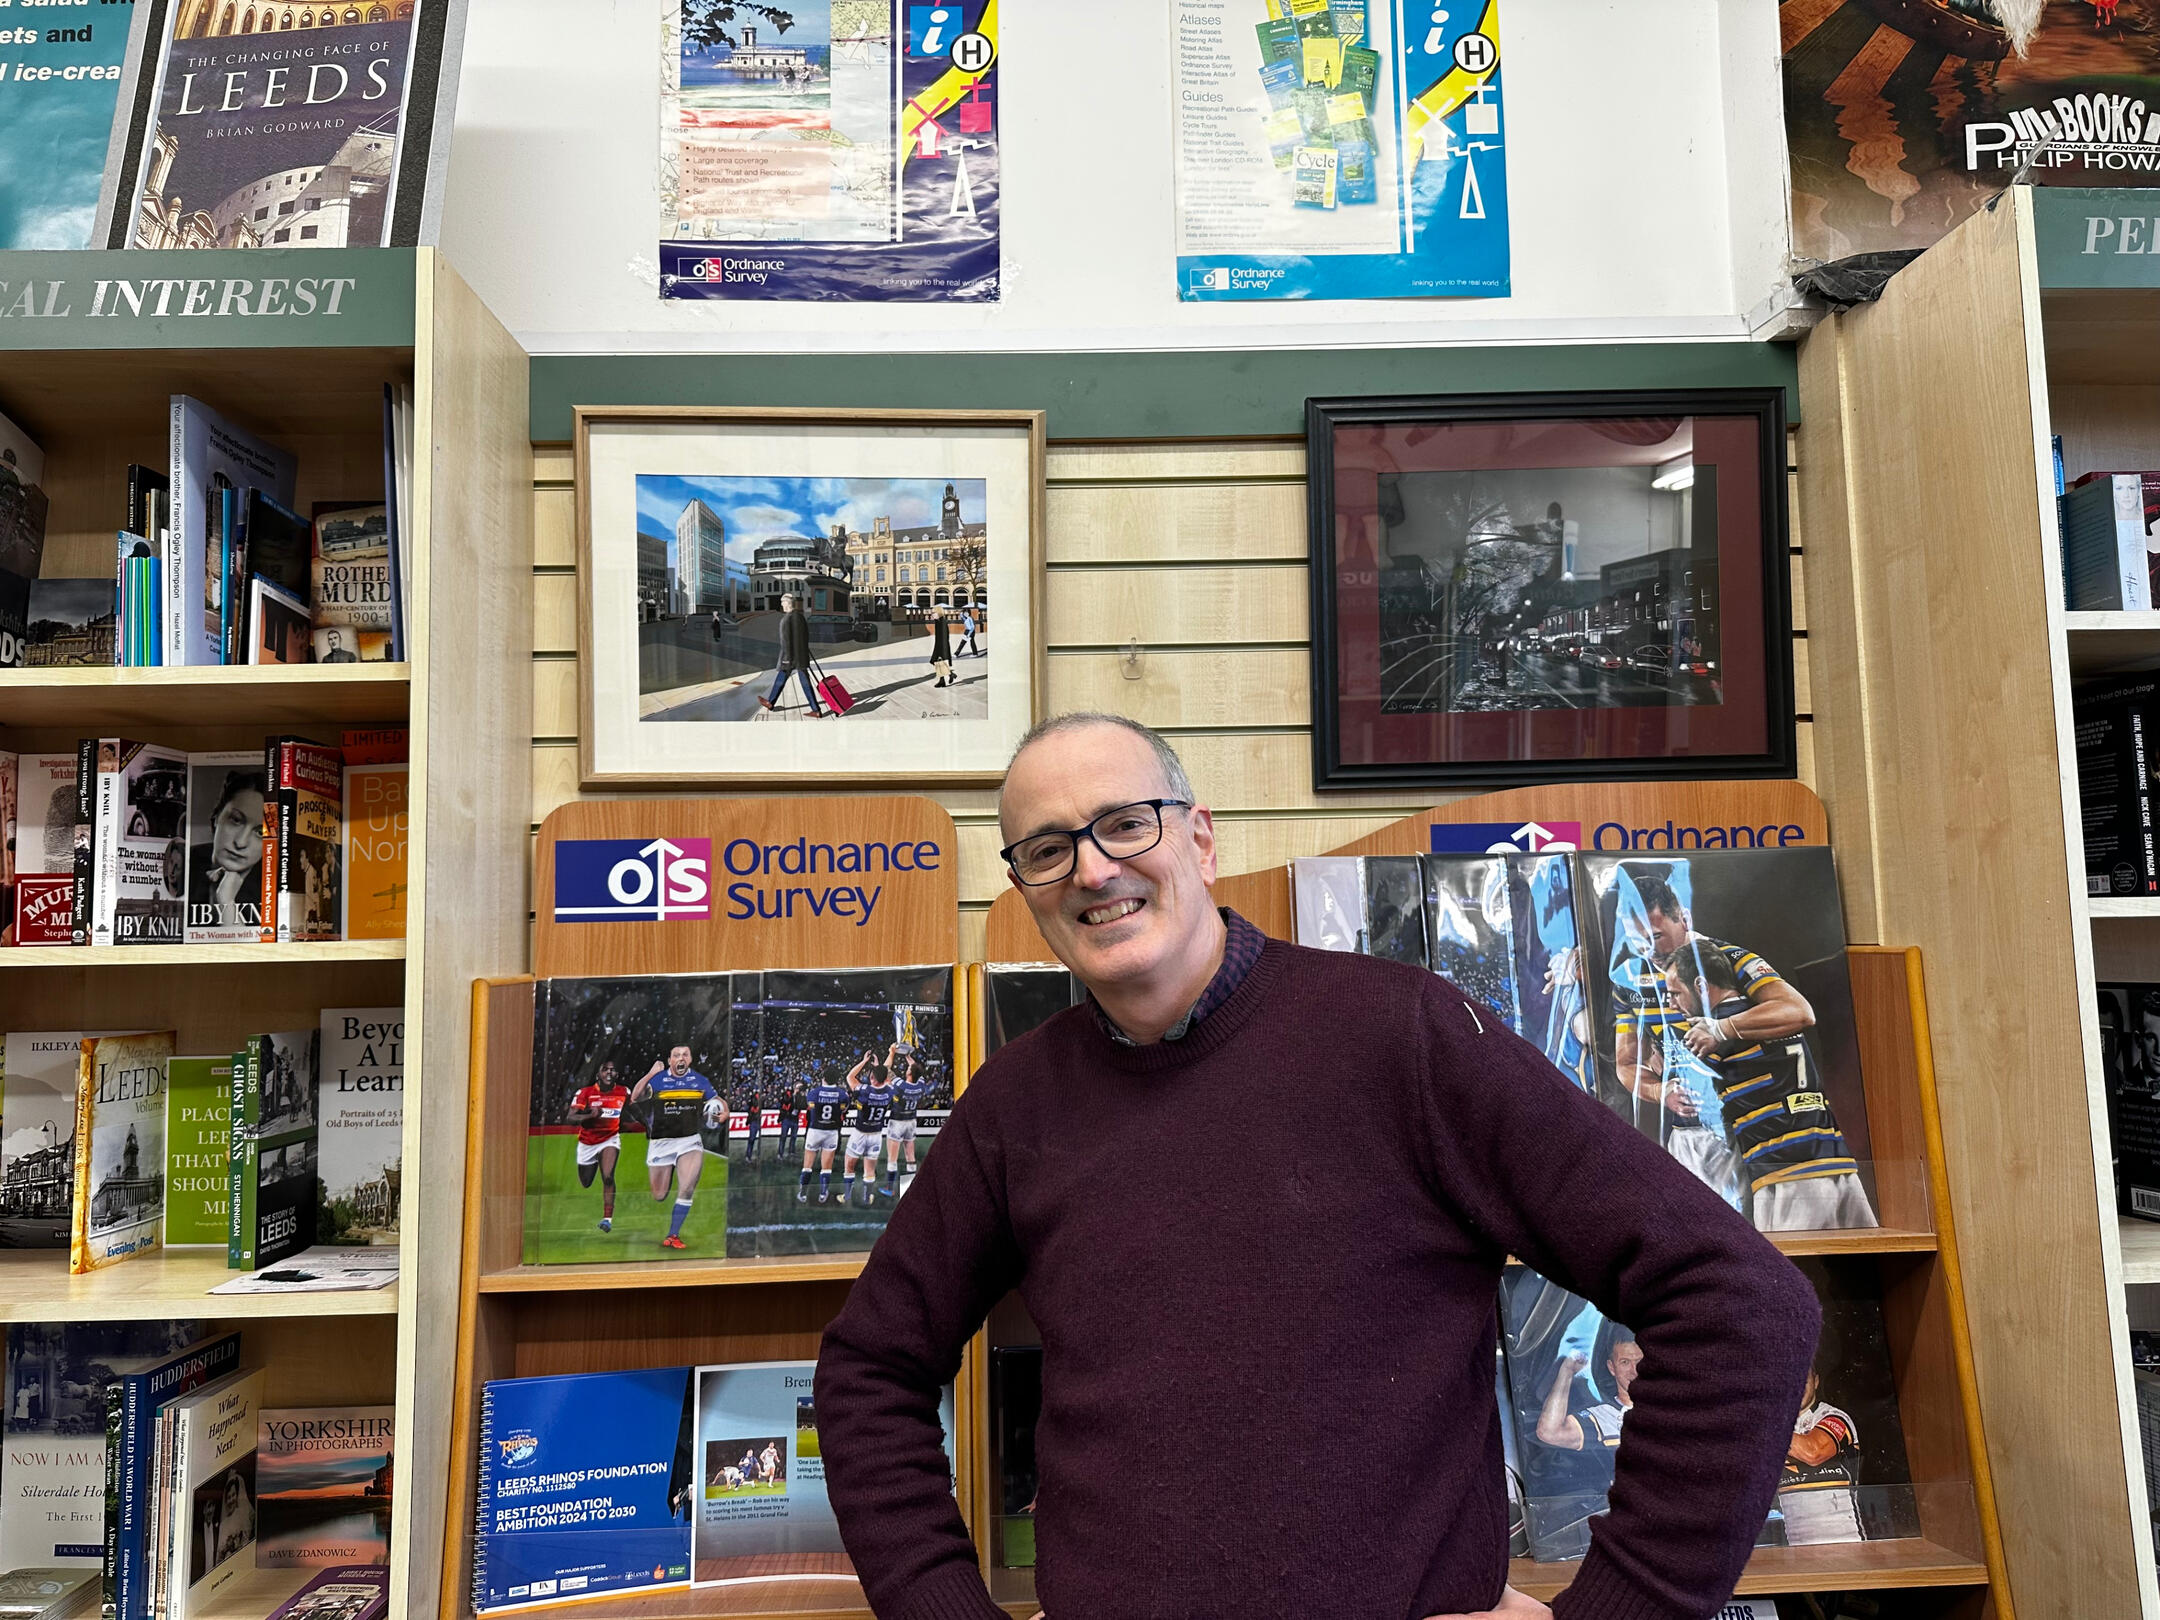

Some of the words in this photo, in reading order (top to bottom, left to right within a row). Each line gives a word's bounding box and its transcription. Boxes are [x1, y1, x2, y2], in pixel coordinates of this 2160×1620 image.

[1179, 14, 1222, 26] Atlases
[46, 24, 93, 43] and
[188, 56, 218, 69] THE
[226, 47, 315, 66] CHANGING
[323, 43, 361, 57] FACE
[369, 41, 391, 52] OF
[176, 58, 390, 116] LEEDS
[1182, 90, 1224, 103] Guides
[2052, 92, 2146, 144] BOOKS
[206, 126, 255, 139] BRIAN
[263, 118, 346, 134] GODWARD
[734, 157, 769, 165] coverage
[1297, 151, 1336, 169] Cycle
[724, 258, 785, 271] Ordnance
[1231, 267, 1286, 279] Ordnance
[724, 271, 769, 286] Survey
[1448, 279, 1456, 287] to
[1456, 279, 1468, 287] the
[1481, 280, 1500, 288] world
[85, 278, 356, 317] INTEREST
[173, 404, 182, 422] Your
[174, 423, 182, 470] affectionate
[209, 436, 228, 454] Francis
[222, 432, 255, 458] affectionate
[173, 470, 182, 501] brother,
[173, 503, 182, 531] Francis
[173, 531, 182, 556] Ogley
[173, 557, 182, 599] Thompson
[2135, 683, 2155, 694] Stage
[2132, 713, 2141, 733] FAITH,
[342, 731, 404, 747] LIMITED
[2134, 733, 2143, 750] HOPE
[81, 757, 89, 770] you
[295, 748, 307, 761] An
[307, 751, 338, 772] Audience
[2136, 750, 2144, 763] AND
[267, 770, 275, 793] Jenkins
[295, 764, 323, 781] Curious
[2137, 762, 2148, 791] CARNAGE
[80, 770, 89, 797] strong,
[102, 777, 111, 792] IBY
[102, 793, 110, 817] KNILL
[282, 804, 289, 815] An
[2140, 796, 2150, 812] NICK
[307, 820, 337, 838] PLAYERS
[2142, 812, 2151, 828] CAVE
[281, 815, 289, 848] Audience
[1592, 820, 1805, 850] Ordnance
[2144, 833, 2153, 850] SEAN
[118, 846, 136, 858] The
[136, 850, 167, 861] woman
[281, 848, 289, 856] of
[723, 836, 941, 876] Ordnance
[124, 861, 159, 873] without
[281, 857, 289, 884] Curious
[2145, 849, 2156, 877] O'HAGAN
[77, 877, 86, 895] Kath
[121, 875, 128, 883] a
[129, 874, 163, 886] number
[75, 895, 85, 921] Padgett
[727, 882, 882, 927] Survey
[190, 903, 226, 925] IBY
[117, 915, 144, 937] IBY
[189, 931, 206, 939] The
[206, 930, 236, 939] Woman
[236, 929, 254, 938] with
[31, 1041, 67, 1052] ILKLEY
[356, 1043, 379, 1067] A
[1785, 1042, 1805, 1089] 7
[247, 1056, 258, 1094] LEEDS
[233, 1064, 245, 1112] GHOST
[340, 1109, 376, 1118] Portraits
[376, 1109, 386, 1117] of
[387, 1110, 398, 1119] 25
[821, 1104, 834, 1120] 8
[867, 1106, 884, 1121] 13
[904, 1101, 917, 1111] 10
[326, 1119, 342, 1128] Old
[343, 1119, 363, 1130] Boys
[364, 1118, 374, 1127] of
[375, 1118, 399, 1128] Leeds
[923, 1117, 946, 1127] 2015
[231, 1117, 245, 1161] SIGNS
[171, 1154, 224, 1169] THAT
[233, 1174, 242, 1191] STU
[232, 1192, 242, 1237] HENNIGAN
[260, 1214, 271, 1224] THE
[271, 1210, 289, 1221] STORY
[288, 1206, 297, 1217] OF
[260, 1216, 297, 1245] LEEDS
[106, 1242, 136, 1258] Evening
[140, 1234, 154, 1248] Post
[150, 1340, 236, 1394] HUDDERSFIELD
[188, 1378, 198, 1392] IN
[217, 1392, 240, 1415] What
[126, 1382, 137, 1453] HUDDERSFIELD
[207, 1401, 248, 1440] Happened
[265, 1418, 394, 1441] YORKSHIR
[215, 1433, 238, 1459] Next?
[269, 1441, 283, 1452] IN
[286, 1437, 383, 1451] PHOTOGRAPHS
[498, 1435, 539, 1457] RHINOS
[10, 1452, 49, 1467] NOW
[55, 1452, 59, 1467] I
[65, 1452, 88, 1466] AM
[126, 1453, 135, 1466] IN
[125, 1466, 135, 1503] WORLD
[497, 1475, 537, 1491] LEEDS
[538, 1470, 586, 1486] RHINOS
[587, 1461, 668, 1481] FOUNDATION
[20, 1485, 80, 1498] Silverdale
[496, 1486, 532, 1498] CHARITY
[532, 1484, 545, 1493] NO.
[46, 1511, 66, 1521] The
[70, 1511, 94, 1521] First
[124, 1503, 133, 1525] WAR
[496, 1507, 531, 1521] BEST
[529, 1496, 612, 1517] FOUNDATION
[495, 1514, 557, 1533] AMBITION
[558, 1511, 587, 1525] 2024
[588, 1509, 607, 1521] TO
[608, 1505, 637, 1518] 2030
[109, 1525, 115, 1535] A
[58, 1546, 95, 1554] FRANCES
[108, 1535, 116, 1548] Day
[268, 1549, 294, 1559] DAVE
[297, 1548, 357, 1558] ZDANOWICZ
[107, 1559, 115, 1578] Dale
[122, 1569, 129, 1578] by
